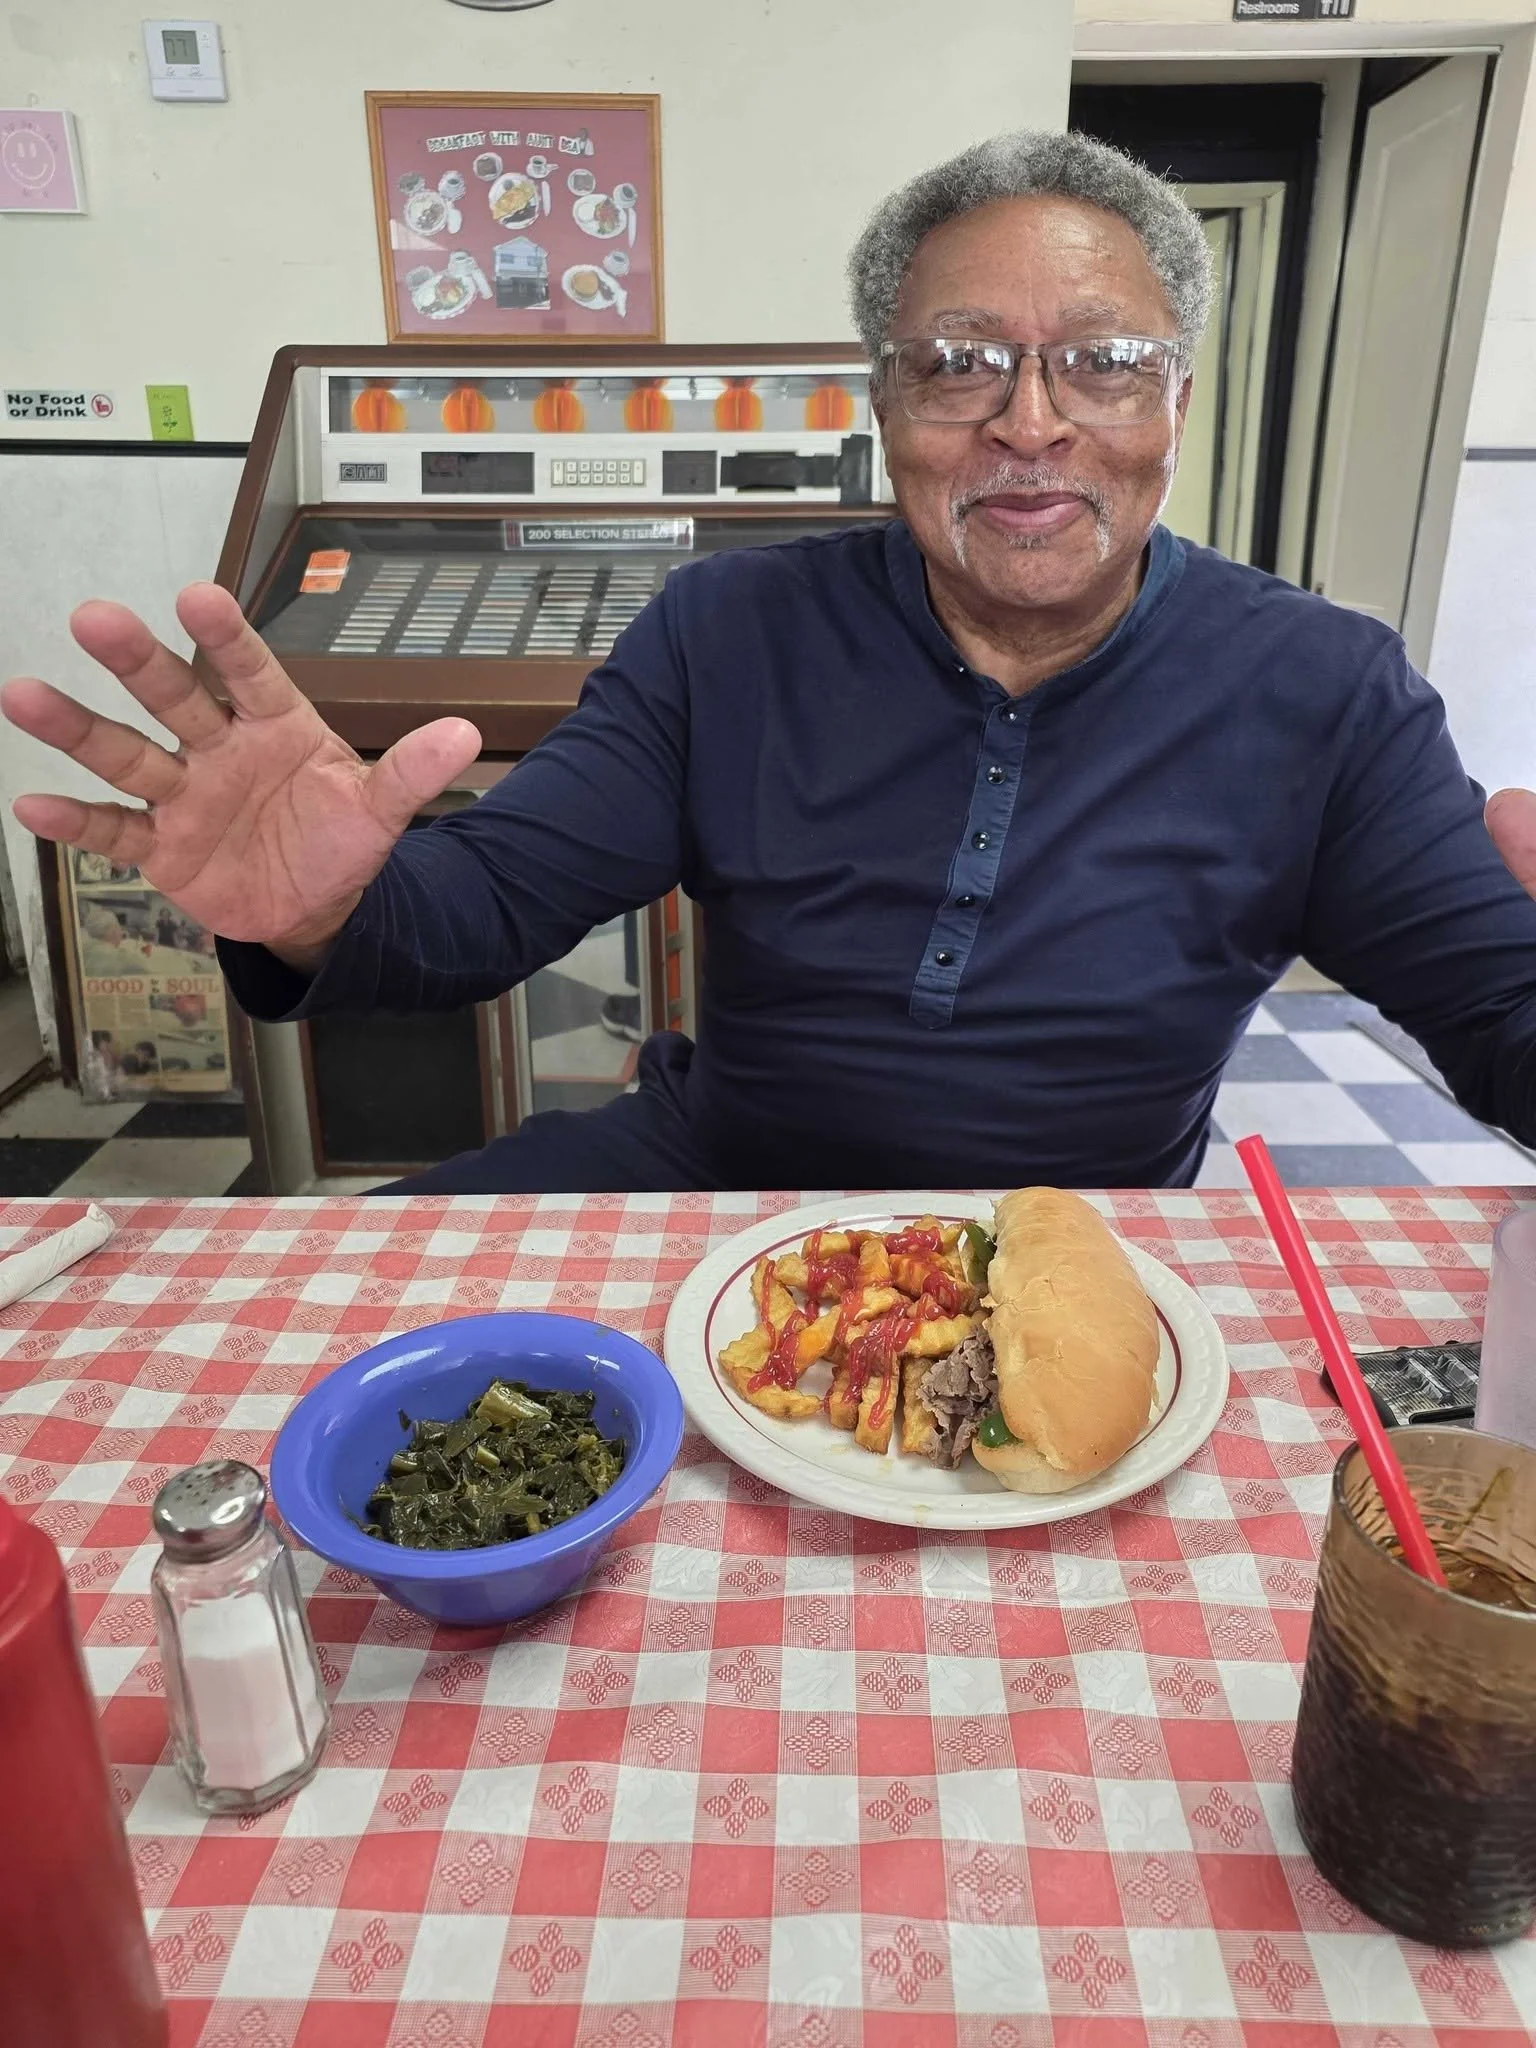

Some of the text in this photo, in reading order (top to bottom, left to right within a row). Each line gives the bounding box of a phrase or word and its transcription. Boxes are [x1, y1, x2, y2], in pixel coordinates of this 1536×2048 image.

[1237, 1, 1300, 14] Restrooms
[7, 394, 86, 405] No Food
[9, 406, 87, 417] or Drink
[528, 528, 670, 540] 200 SELECTION STEREO
[87, 978, 144, 994] GOOD
[165, 977, 219, 994] SOUL
